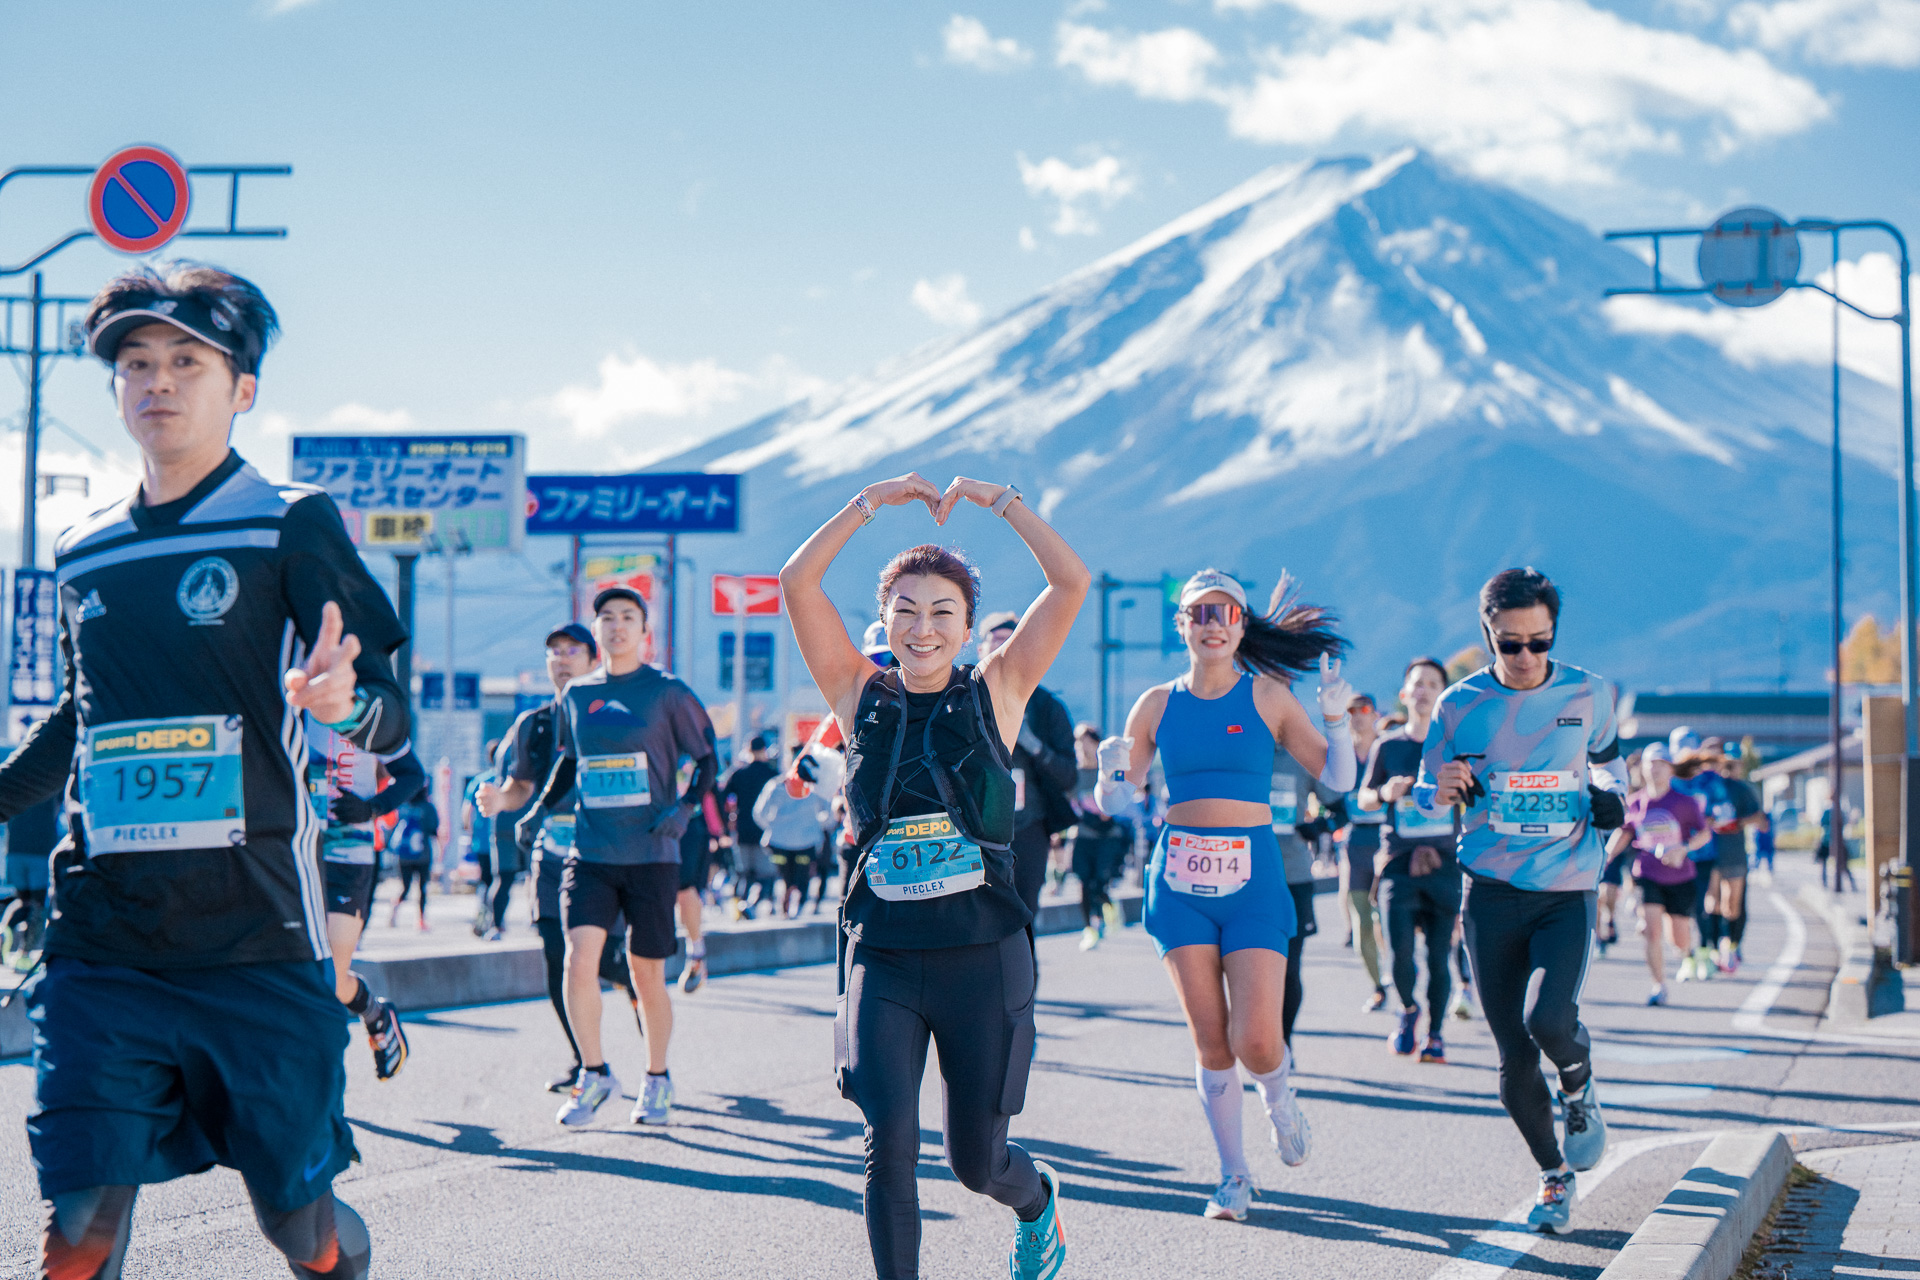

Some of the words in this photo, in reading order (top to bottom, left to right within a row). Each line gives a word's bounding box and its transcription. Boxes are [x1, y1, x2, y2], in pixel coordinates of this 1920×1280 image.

[301, 460, 502, 483] ファミリーオート
[329, 485, 502, 508] ービスセンター
[540, 484, 731, 521] ファミリーオート
[136, 727, 211, 750] DEPO
[114, 762, 214, 803] 1957
[599, 772, 637, 788] 1711
[1513, 794, 1568, 812] 2235
[113, 826, 178, 842] PIECLEX
[885, 827, 905, 836] SPORTS
[905, 820, 951, 836] DEPO
[891, 840, 965, 870] 6122
[1187, 855, 1239, 874] 6014
[902, 880, 945, 895] PIECLEX
